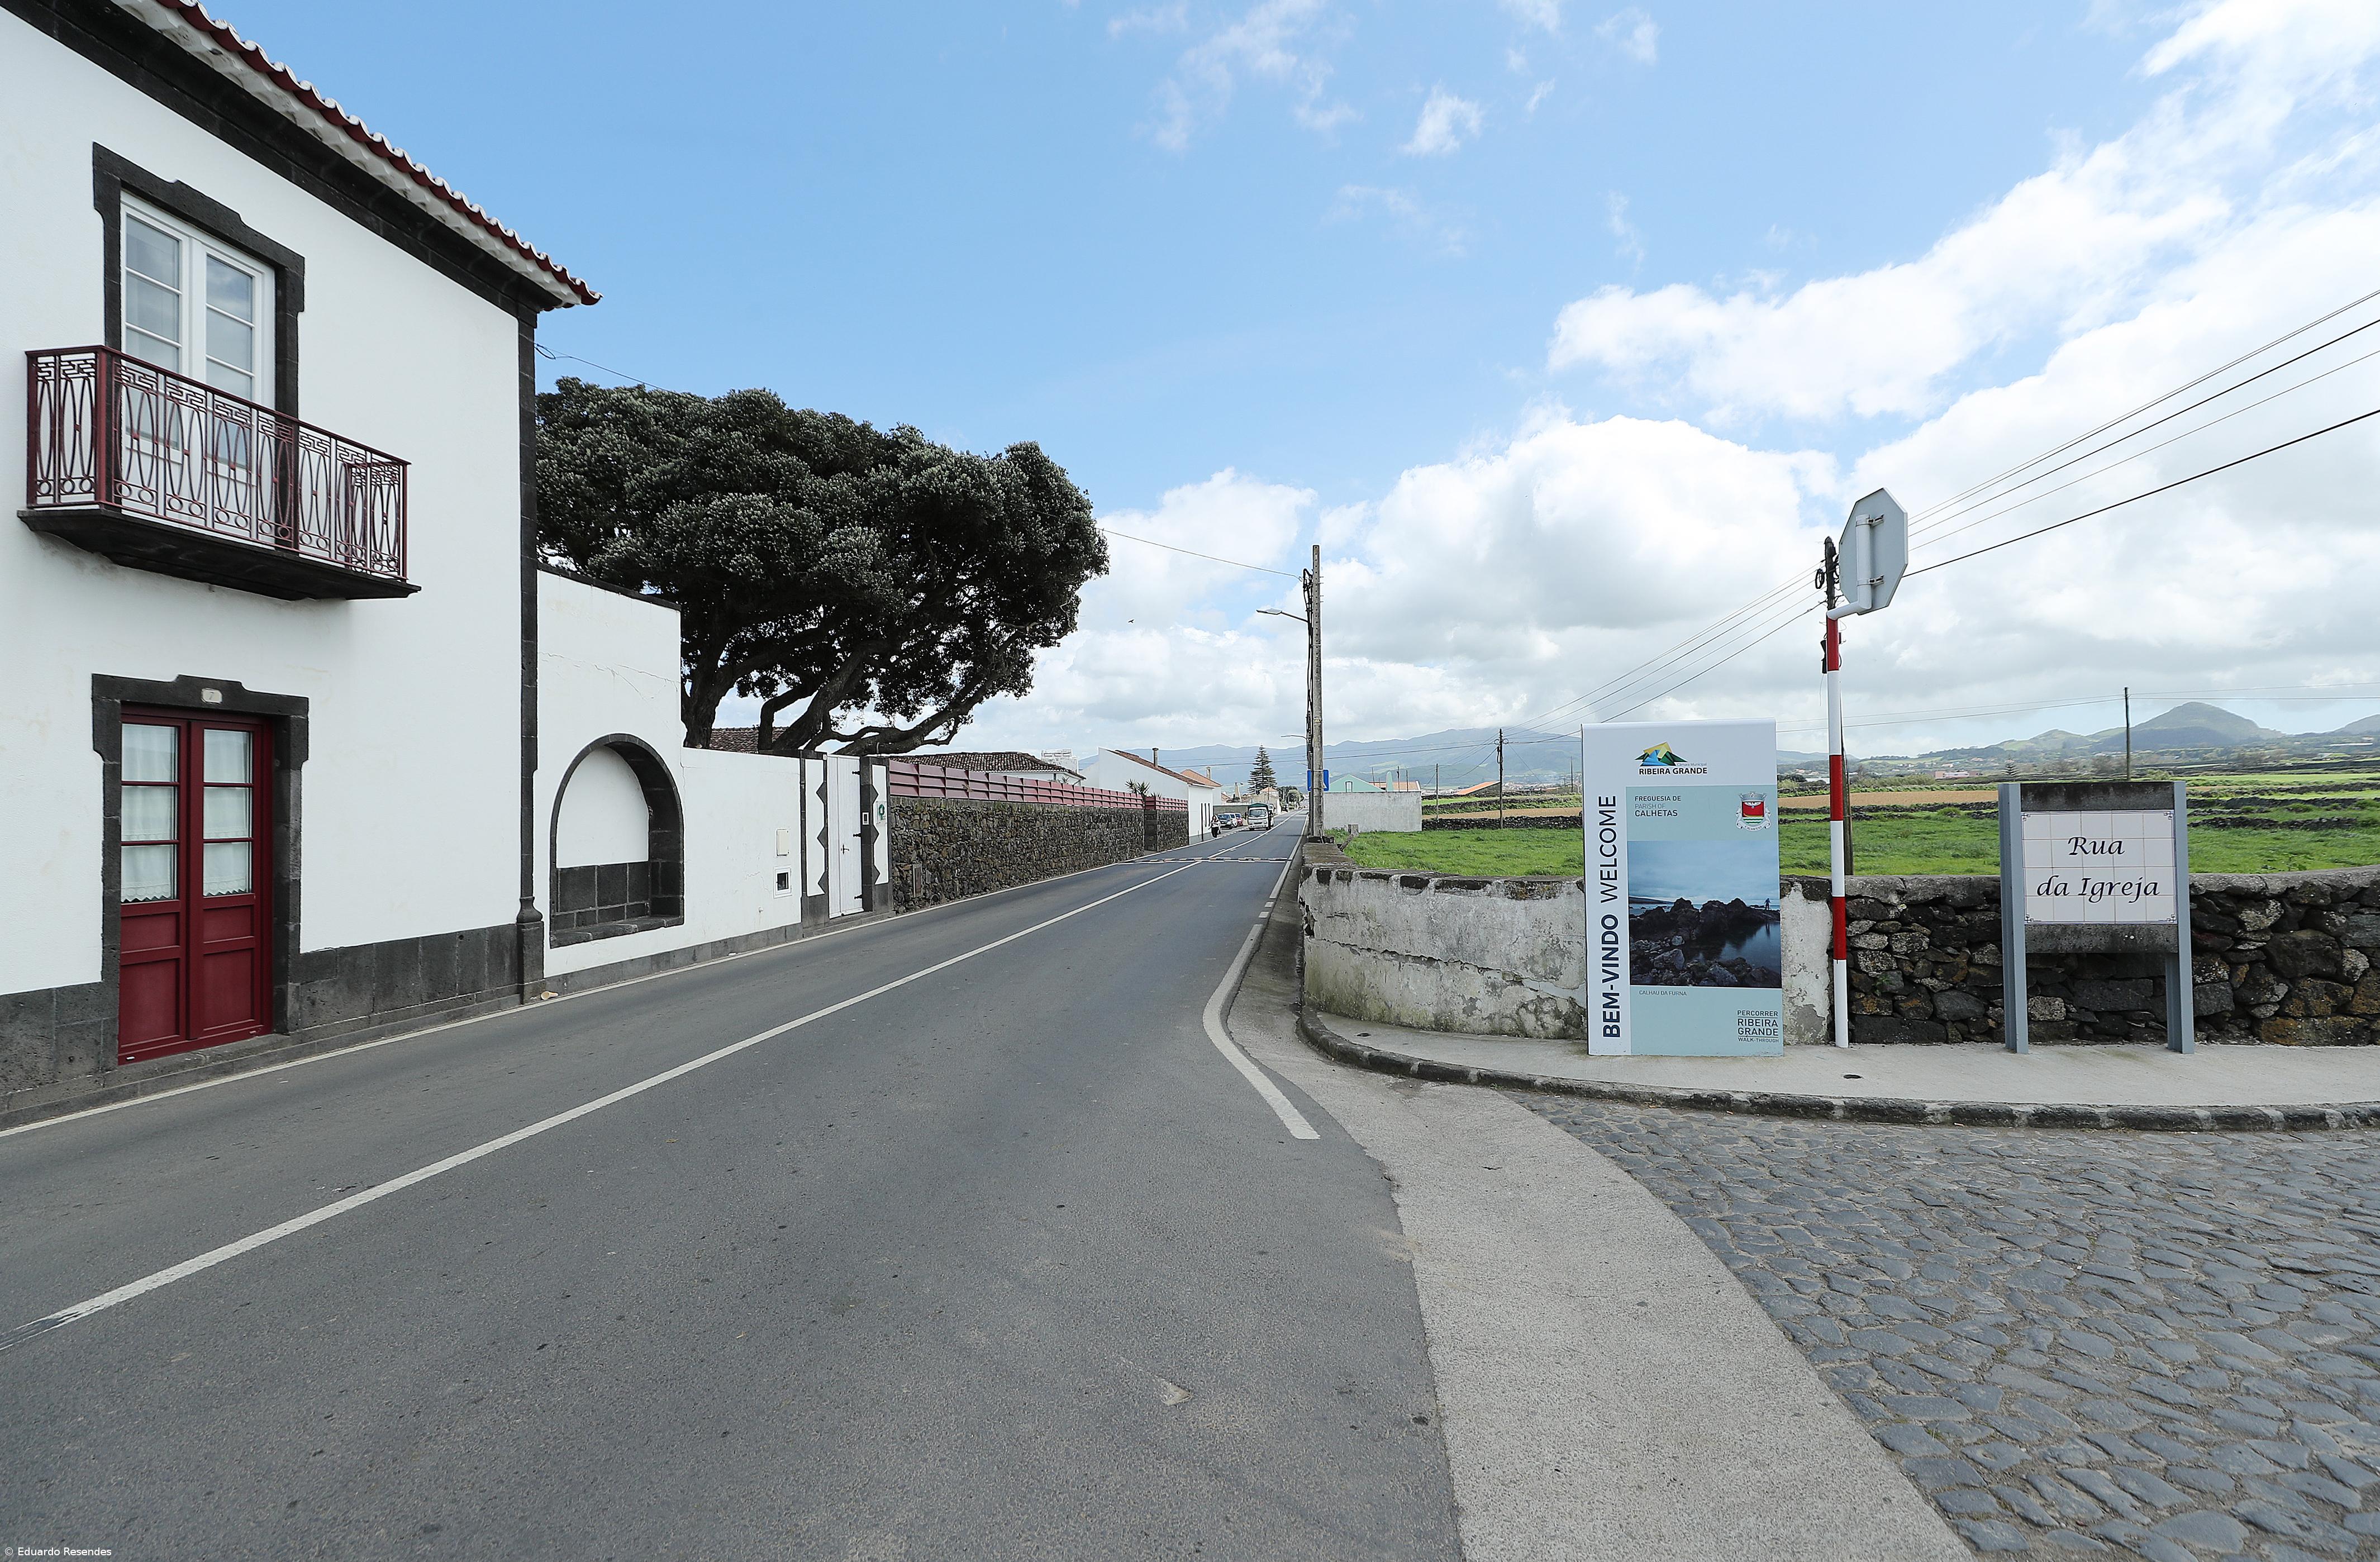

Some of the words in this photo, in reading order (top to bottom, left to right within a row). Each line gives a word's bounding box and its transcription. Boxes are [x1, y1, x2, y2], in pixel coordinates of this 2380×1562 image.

[1598, 796, 1618, 903] WELCOME
[2067, 837, 2125, 856] Rua
[2036, 875, 2069, 896] da
[2077, 877, 2160, 903] Igreja
[1601, 914, 1621, 1037] BEM-VINDO
[1738, 1018, 1778, 1027] RIBEIRA
[1738, 1027, 1778, 1036] GRANDE
